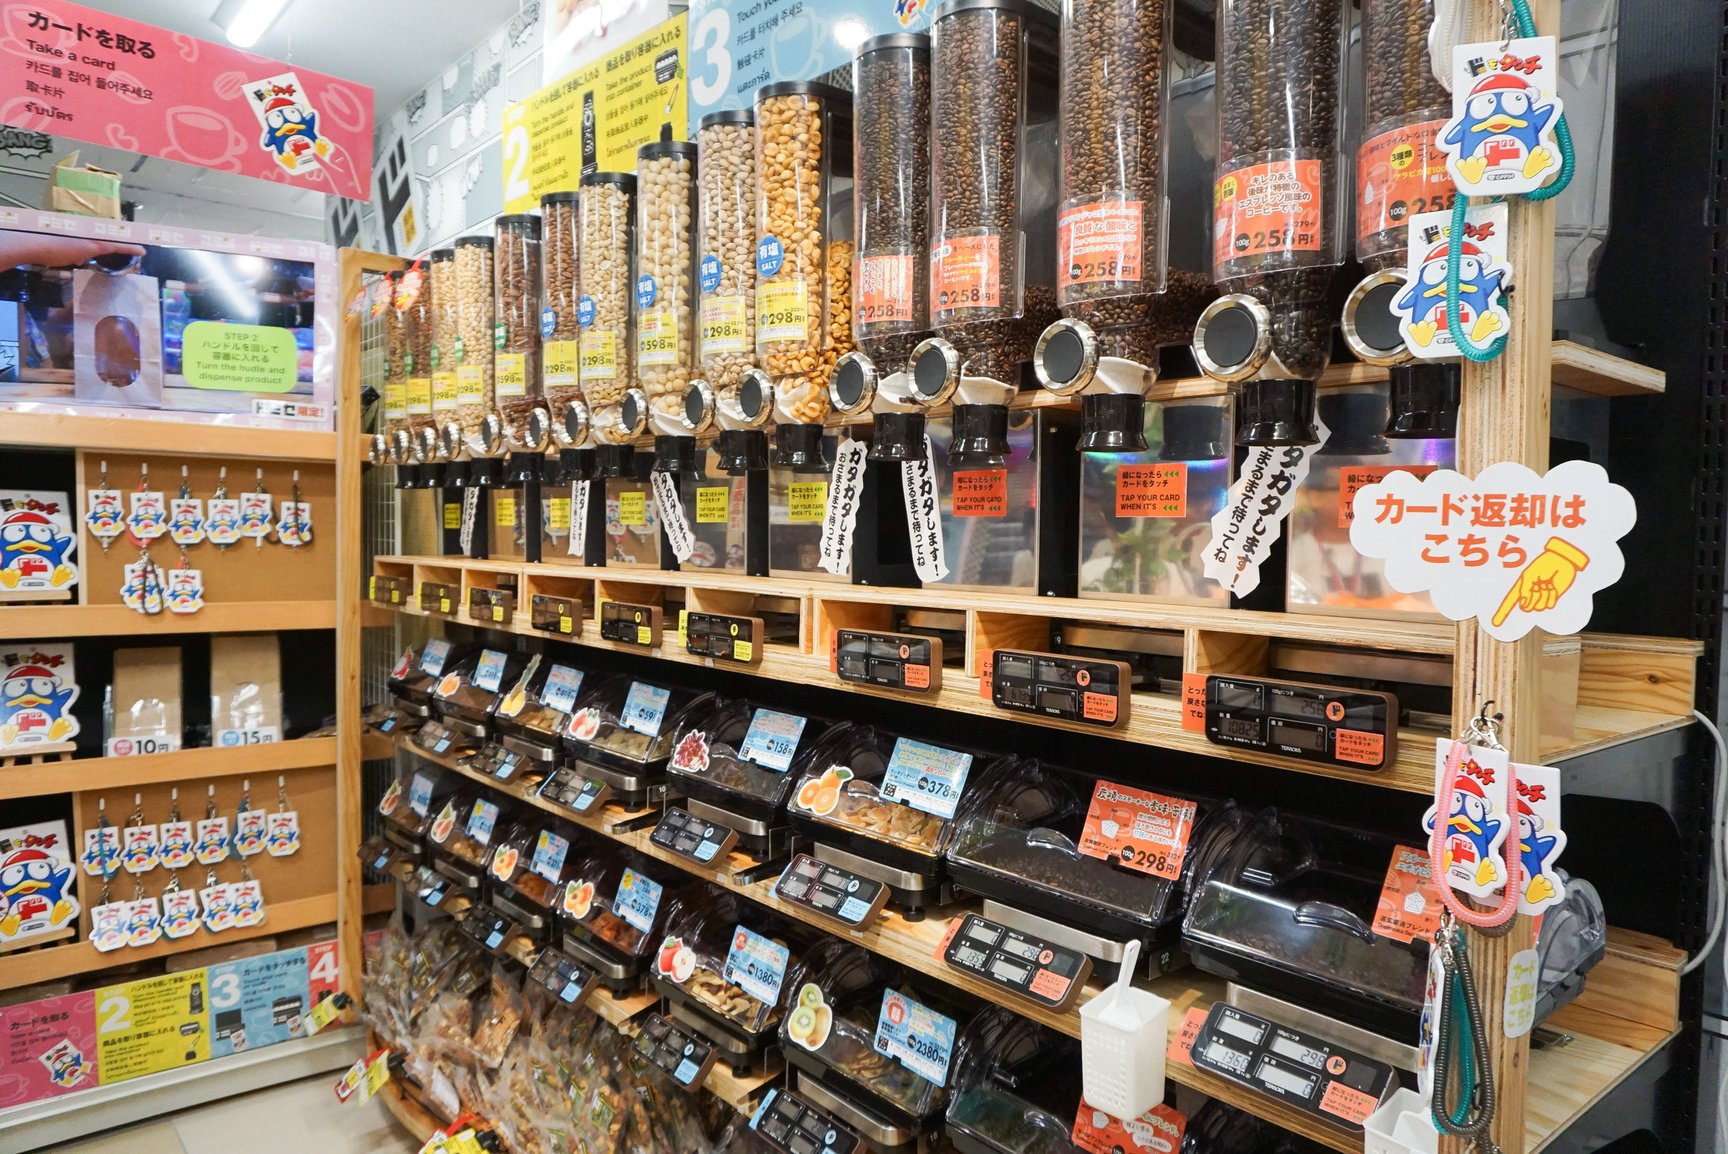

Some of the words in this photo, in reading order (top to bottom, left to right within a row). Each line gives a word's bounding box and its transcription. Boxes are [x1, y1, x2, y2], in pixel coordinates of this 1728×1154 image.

[737, 6, 761, 24] Touch
[757, 19, 778, 37] 터치해
[779, 5, 803, 24] 주세요
[28, 12, 155, 59] カードを取る
[26, 39, 63, 57] Take
[68, 52, 77, 61] a
[82, 56, 115, 70] card
[691, 8, 732, 106] 3
[26, 60, 62, 78] 카드를
[68, 70, 91, 85] 집어
[96, 77, 153, 100] 들어주세요
[505, 125, 529, 200] 2
[1392, 150, 1412, 162] 3種類
[1253, 173, 1295, 185] キレのある
[1248, 184, 1299, 197] 後味が特徴の
[1239, 193, 1311, 209] エスプレッソ風味の
[1246, 204, 1303, 217] コーヒーです。
[1390, 207, 1406, 216] 100g
[759, 243, 778, 257] 有塩
[702, 262, 717, 276] 有塩
[761, 261, 777, 271] SALT
[638, 281, 653, 293] 有塩
[702, 278, 715, 287] SALT
[639, 295, 651, 304] SALT
[225, 332, 249, 341] STEP
[202, 341, 278, 354] ハンドルを回して
[212, 352, 269, 363] 容器に入れる
[196, 361, 218, 369] Turn
[268, 367, 285, 375] and
[199, 373, 242, 382] dispense
[245, 376, 282, 385] product
[958, 476, 989, 484] 緑になったら
[1122, 471, 1162, 479] 緑になったら
[1122, 480, 1168, 488] カードをタッチ
[825, 452, 846, 558] おさまるまで待ってね
[836, 447, 862, 573] ガタガタします!
[1374, 493, 1587, 529] カード返却は
[1231, 446, 1306, 589] タガタします!
[1420, 533, 1528, 568] こちら
[241, 731, 272, 745] 15円
[135, 739, 169, 755] 10円
[310, 951, 339, 984] 4
[211, 973, 241, 1008] 3
[100, 995, 132, 1034] 2
